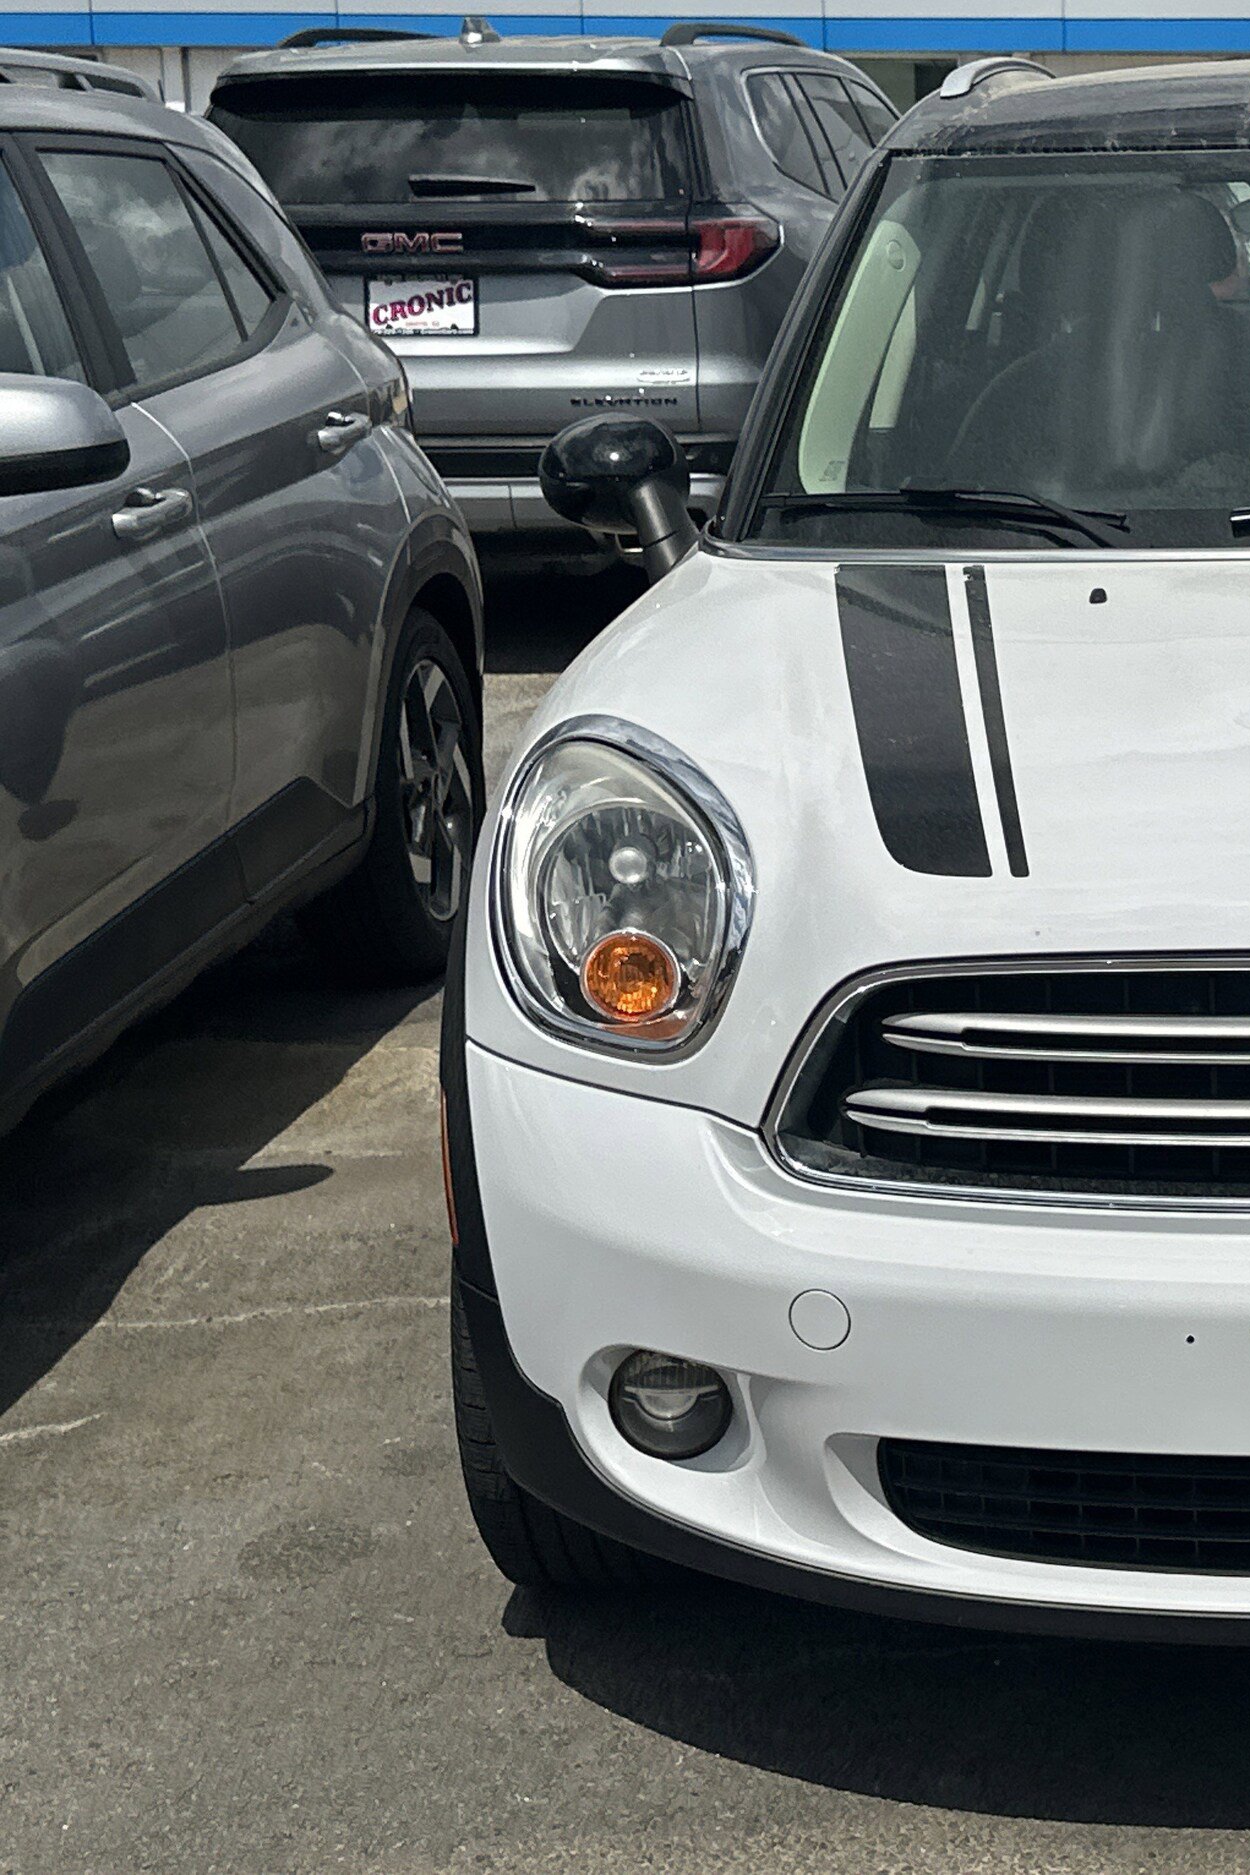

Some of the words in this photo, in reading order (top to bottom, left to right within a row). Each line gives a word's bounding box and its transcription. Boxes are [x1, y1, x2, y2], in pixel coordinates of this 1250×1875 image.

[361, 232, 463, 253] GMC
[373, 282, 472, 325] CRONIC
[570, 397, 678, 406] ELEVATION
